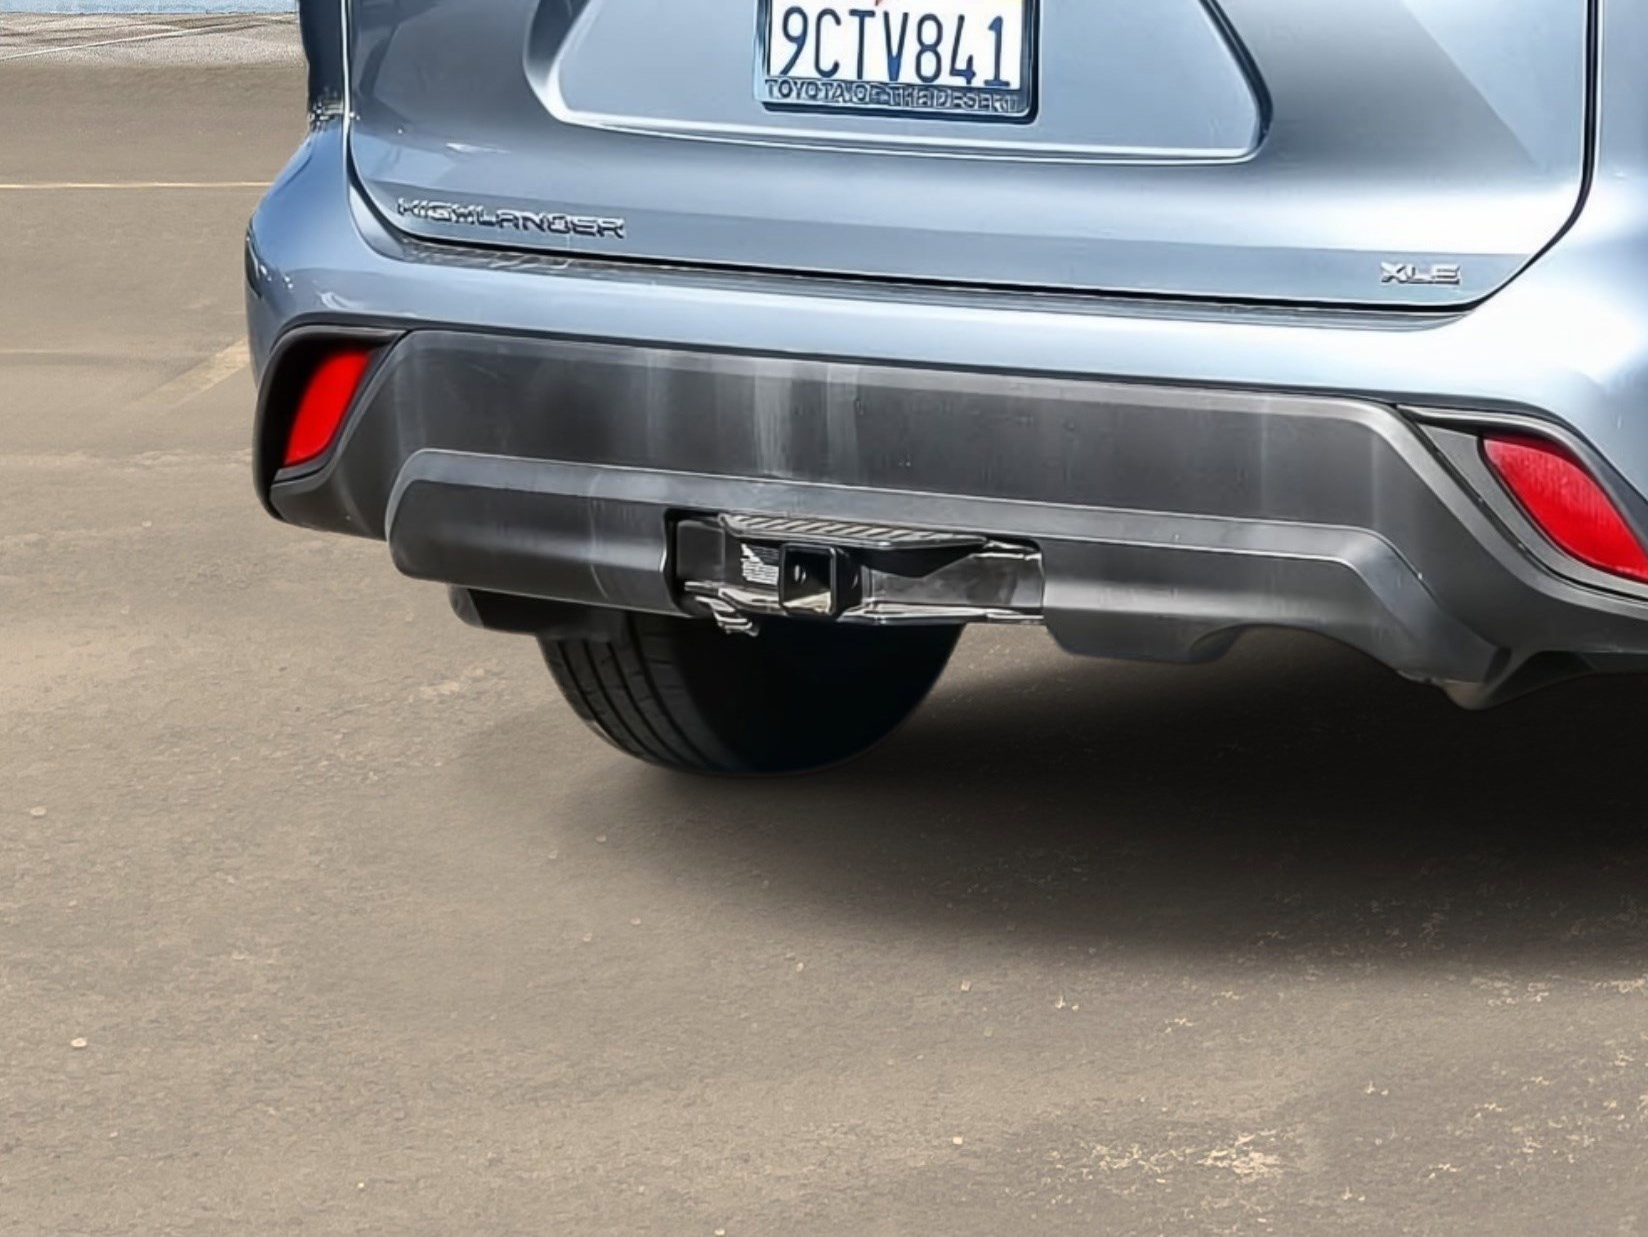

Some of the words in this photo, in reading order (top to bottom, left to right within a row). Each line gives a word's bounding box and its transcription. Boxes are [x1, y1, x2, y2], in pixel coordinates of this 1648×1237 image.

[780, 6, 1011, 88] 9CTV841
[765, 78, 847, 104] TOYOTA
[398, 198, 626, 239] HIGHLANDER
[1380, 261, 1461, 286] XLE
